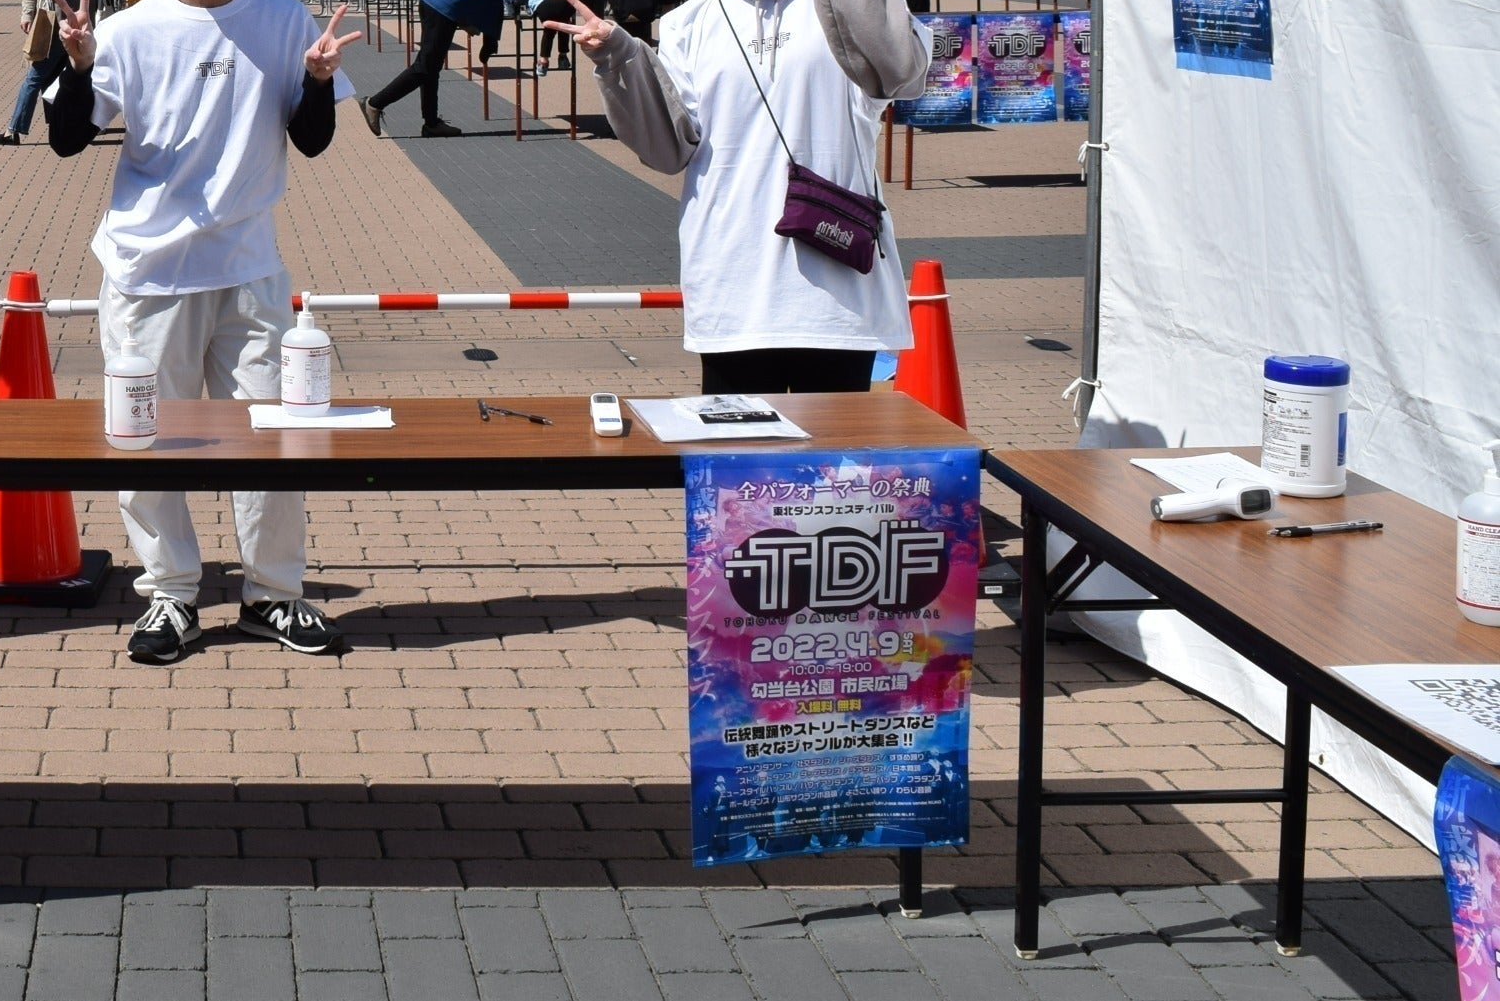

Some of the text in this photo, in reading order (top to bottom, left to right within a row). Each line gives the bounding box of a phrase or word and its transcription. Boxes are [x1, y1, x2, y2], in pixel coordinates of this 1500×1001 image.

[932, 31, 962, 57] DF
[988, 31, 1045, 58] TDF
[195, 58, 235, 77] TDF
[739, 476, 931, 500] 全パフォーマーの祭典
[773, 503, 895, 517] 東北ダンスフェスティバル
[1468, 524, 1484, 532] HAND
[725, 520, 945, 610] TDF
[724, 609, 940, 628] TOHOKU DANCE FESTIVAL
[751, 631, 914, 662] 2022.4.9 SAT
[752, 675, 908, 698] 勾当台公園 市民広場
[797, 699, 862, 714] 入場料 無料
[724, 715, 935, 743] 伝統舞踊やストリートダンスなど
